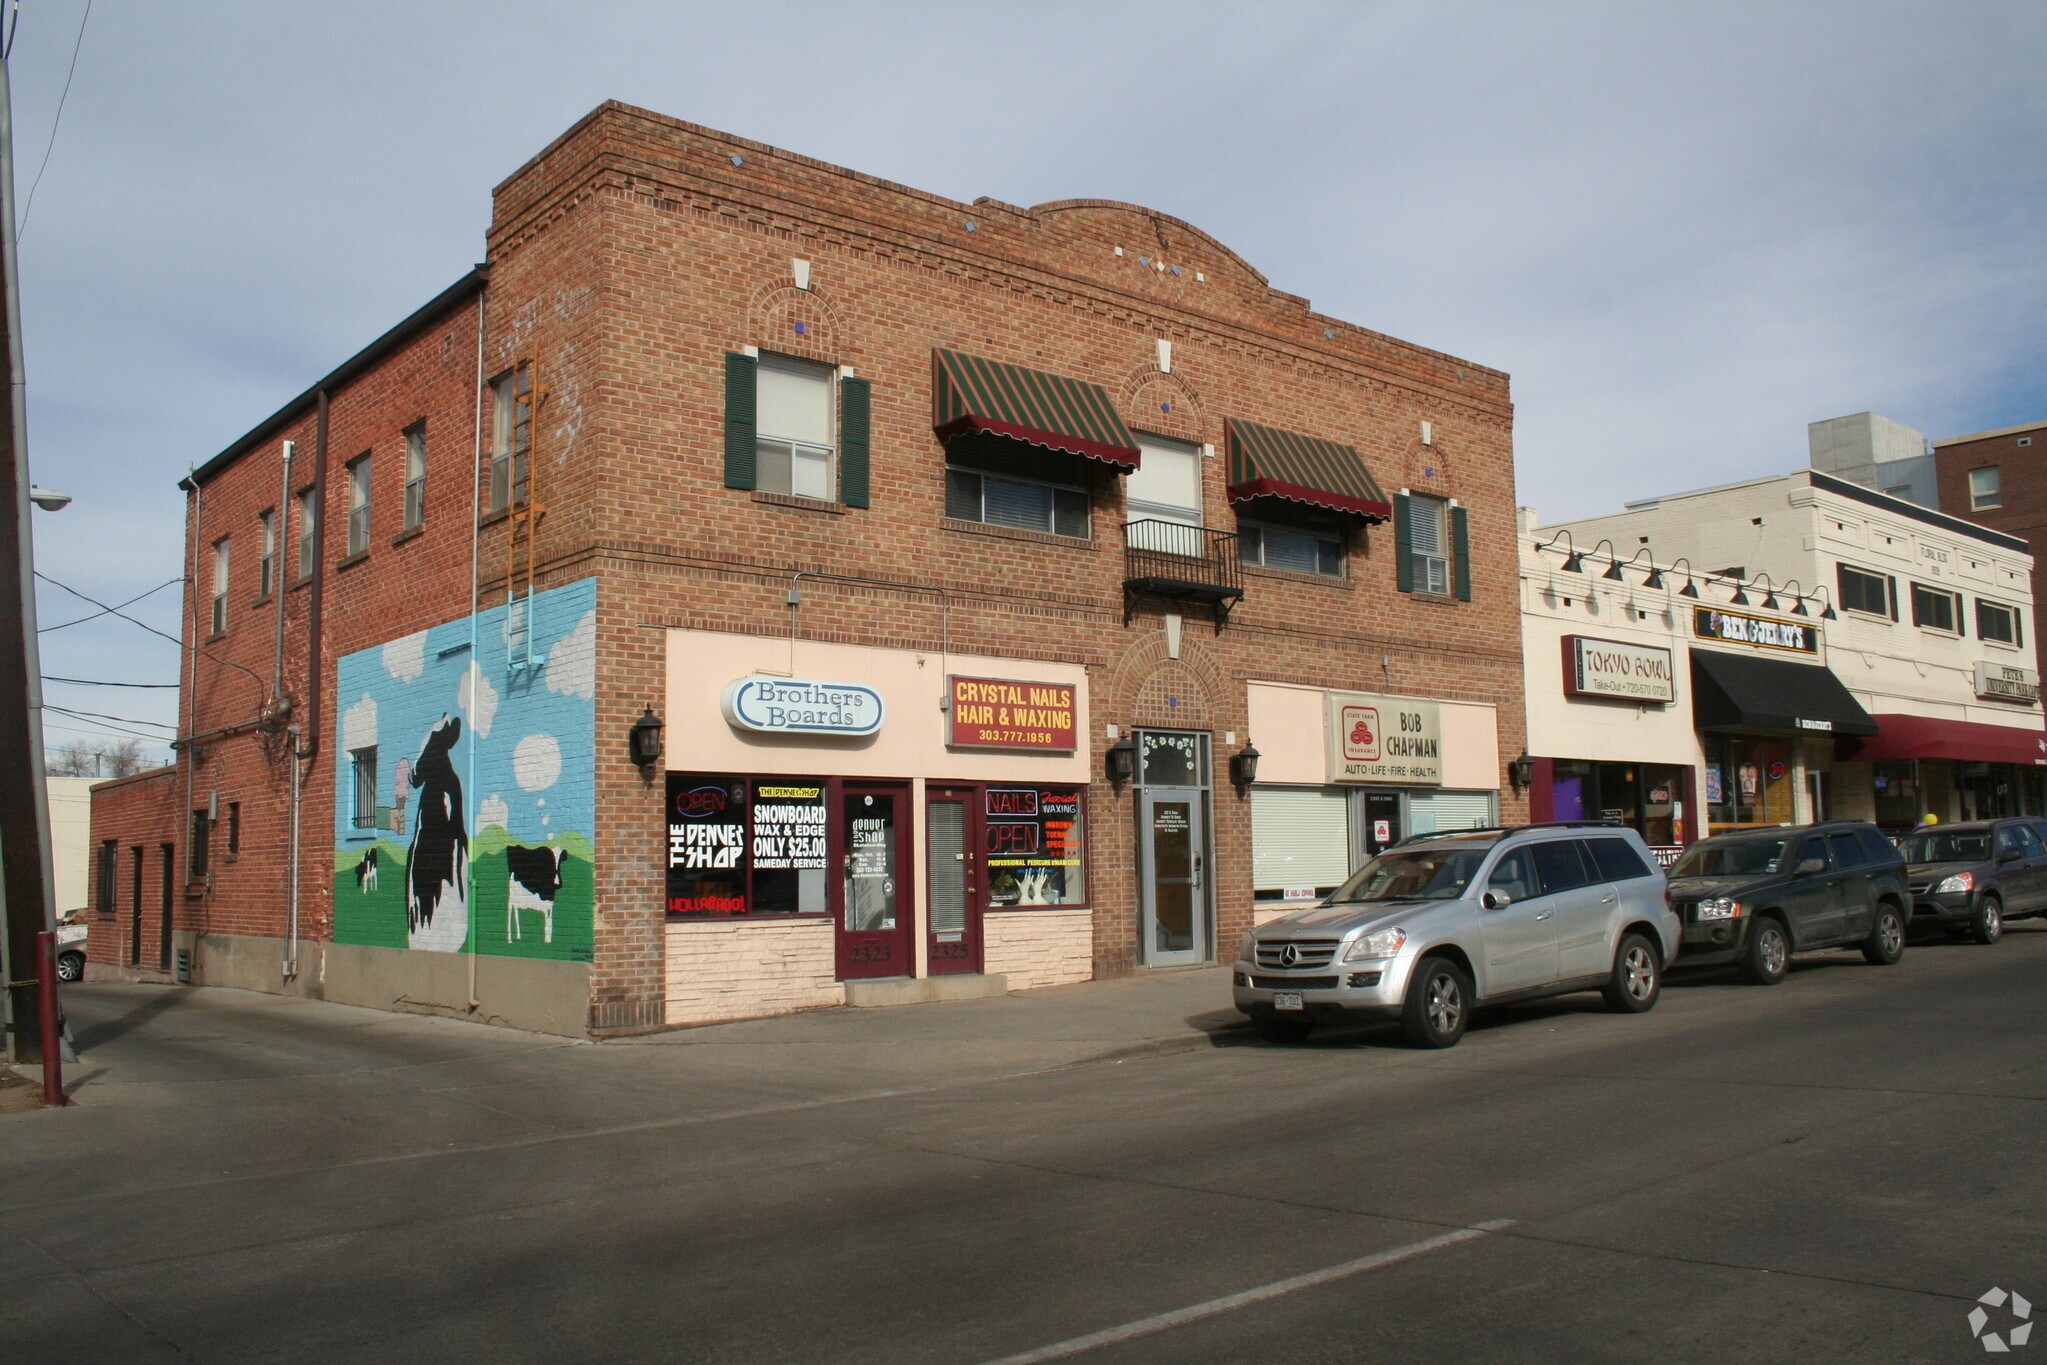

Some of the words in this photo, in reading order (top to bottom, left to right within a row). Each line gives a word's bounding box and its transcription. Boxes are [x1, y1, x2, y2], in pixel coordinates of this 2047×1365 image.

[1722, 614, 1749, 641] BEN
[1586, 649, 1630, 675] TOKYO
[1635, 656, 1671, 681] BOWL
[756, 681, 863, 707] Brothers
[957, 682, 1027, 705] CRYSTAL
[1030, 687, 1071, 708] NAILS
[1593, 679, 1622, 691] Take-Out
[766, 705, 854, 727] Boards
[957, 704, 993, 725] HAIR
[998, 707, 1010, 726] &
[1014, 708, 1071, 729] WAXING
[1400, 712, 1422, 732] BOB
[979, 729, 1052, 744] 303.777.1956
[1386, 736, 1437, 758] CHAPMAN
[1345, 764, 1367, 774] AUTO
[1371, 765, 1386, 775] LIFE
[1390, 766, 1406, 776] FIRE
[1410, 767, 1437, 777] HEALTH
[677, 792, 725, 811] OPEN
[760, 788, 773, 796] THE
[801, 788, 818, 797] SHOP
[1040, 791, 1079, 804] Facial
[988, 793, 1036, 813] NAILS
[1042, 804, 1077, 813] WAXING
[754, 804, 827, 824] SNOWBOARD
[686, 824, 744, 846] DENVER
[753, 824, 780, 836] WAX
[783, 824, 792, 836] &
[795, 824, 826, 836] EDGE
[987, 825, 1037, 852] OPEN
[670, 824, 684, 868] THE
[753, 837, 786, 857] ONLY
[788, 836, 826, 859] $25.00
[685, 846, 743, 868] SHOP
[753, 858, 792, 868] SAMEDAY
[793, 859, 827, 868] SERVICE
[930, 944, 969, 960] 2325
